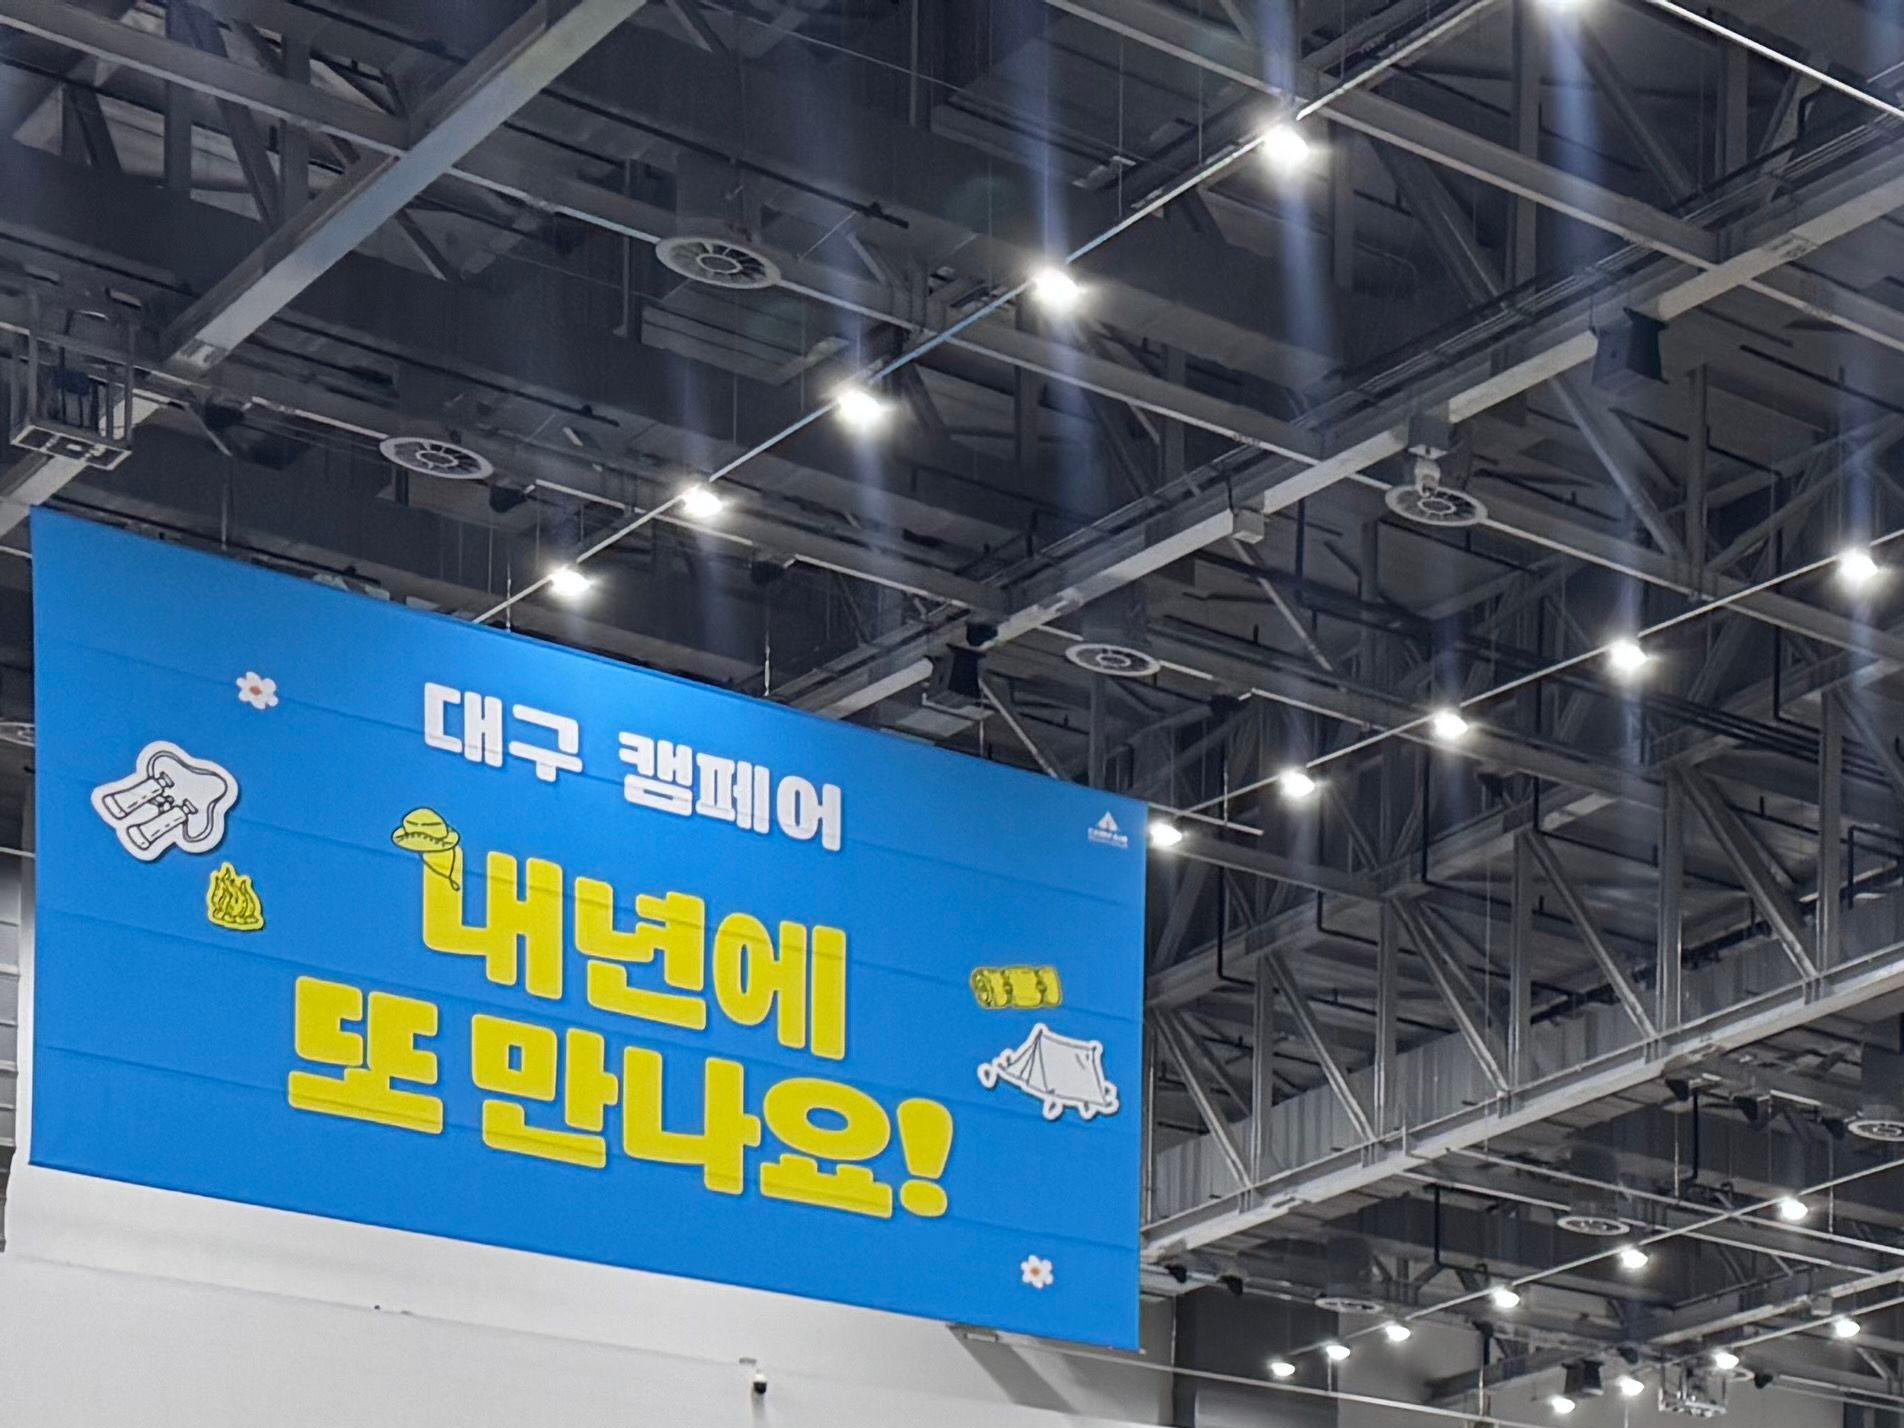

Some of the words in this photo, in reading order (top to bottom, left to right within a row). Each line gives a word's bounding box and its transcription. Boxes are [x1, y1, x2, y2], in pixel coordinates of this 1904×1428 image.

[424, 680, 583, 783] 대구
[618, 729, 842, 852] 캠페어
[422, 848, 848, 1062] 내년에
[286, 975, 445, 1135] 또
[470, 1012, 955, 1220] 만나요!
